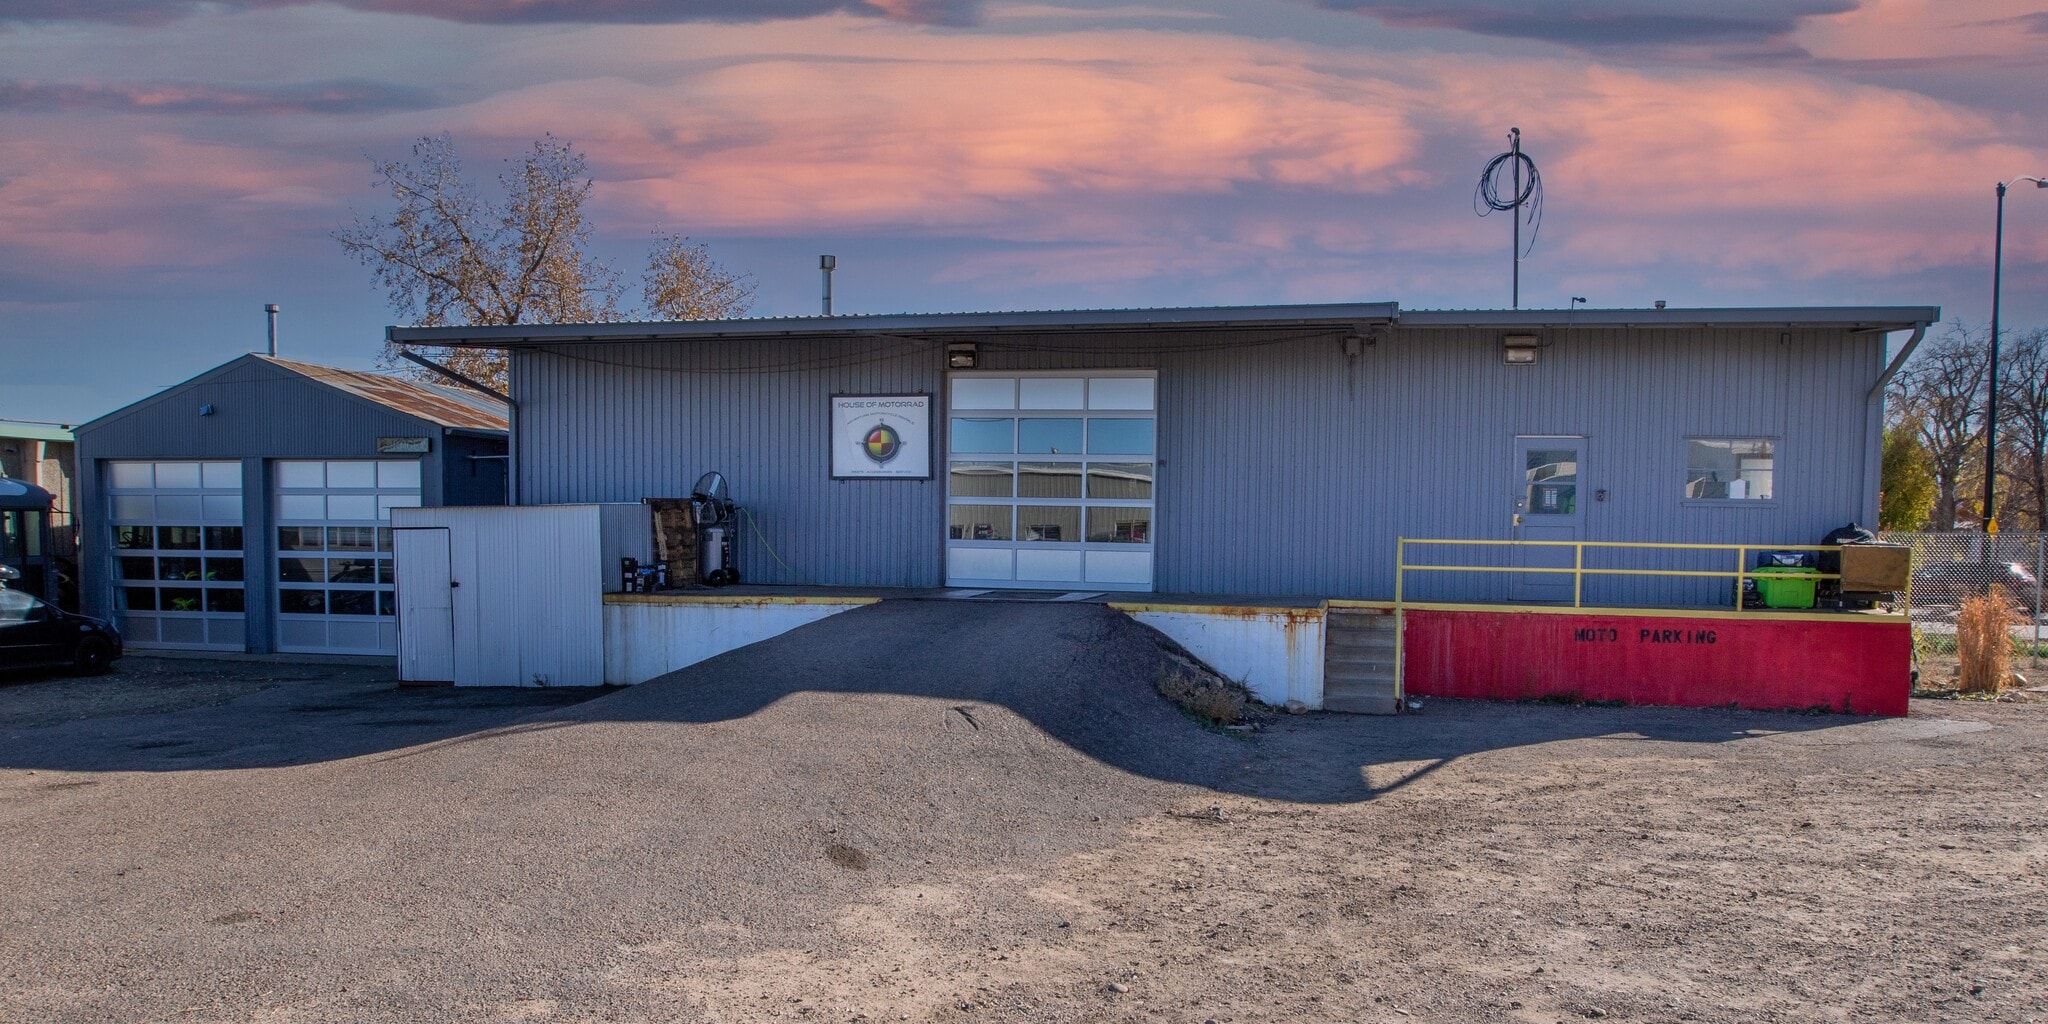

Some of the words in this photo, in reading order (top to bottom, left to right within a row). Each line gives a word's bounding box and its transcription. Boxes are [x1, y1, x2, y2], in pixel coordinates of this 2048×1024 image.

[838, 401, 865, 409] HOUSE
[1574, 628, 1618, 642] MOTO
[1639, 628, 1717, 644] PARKING
